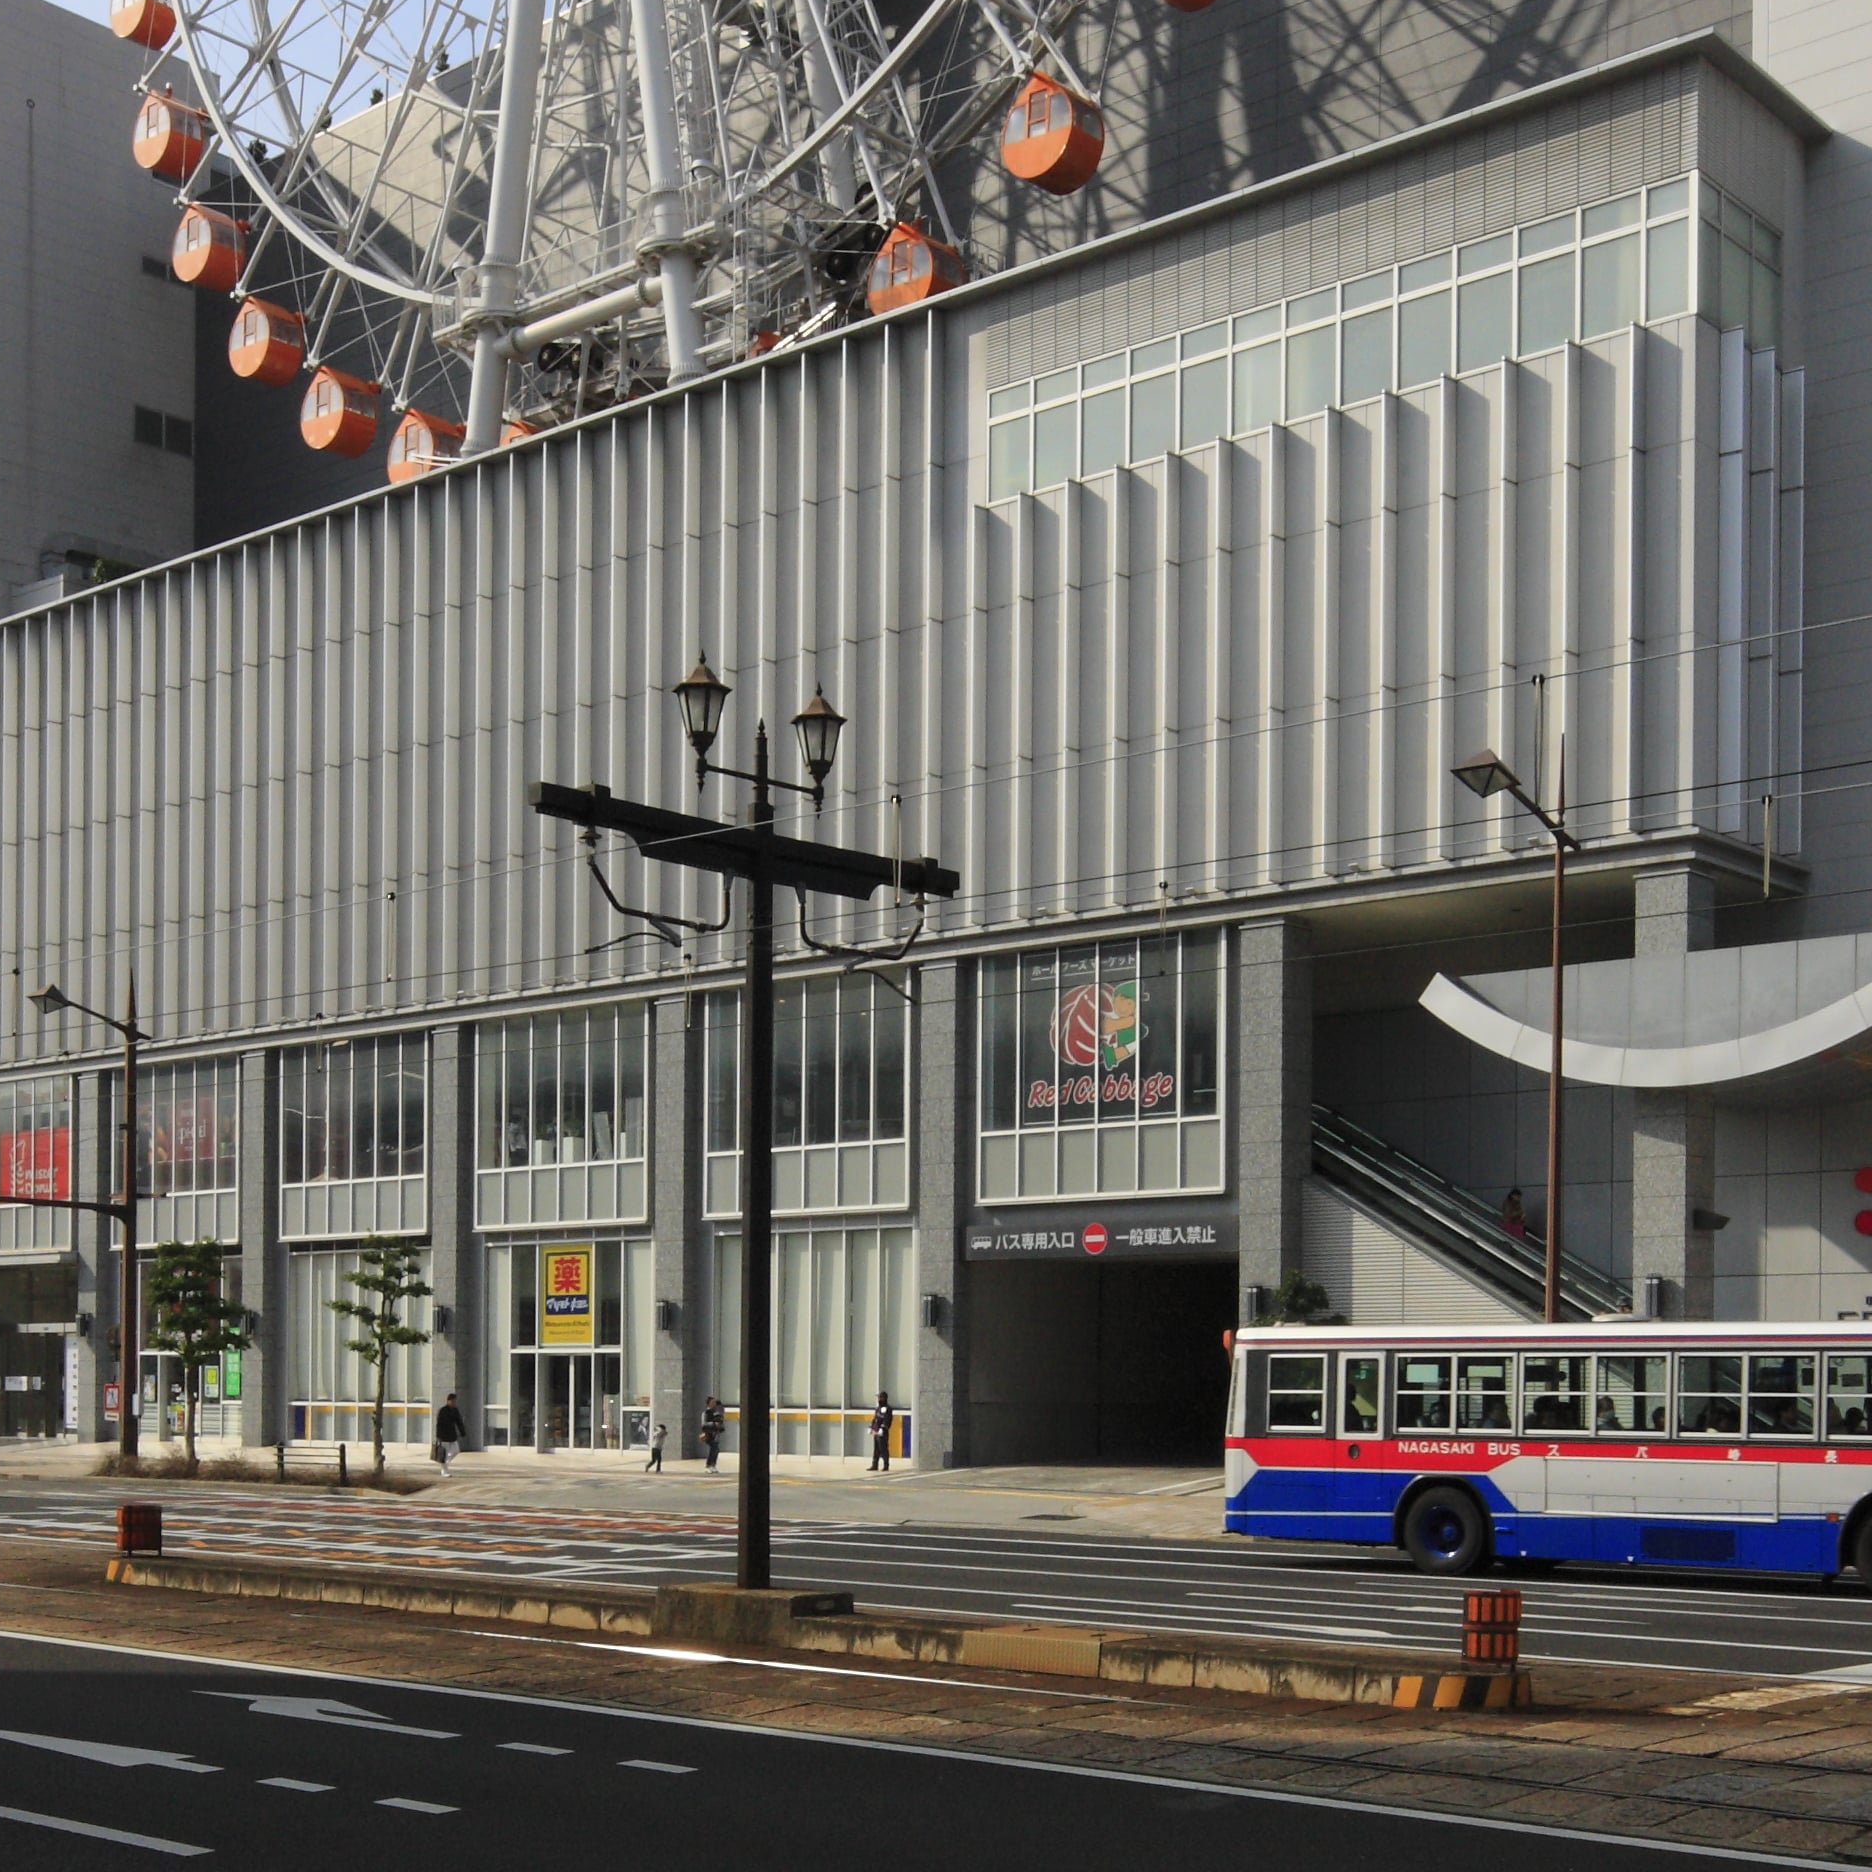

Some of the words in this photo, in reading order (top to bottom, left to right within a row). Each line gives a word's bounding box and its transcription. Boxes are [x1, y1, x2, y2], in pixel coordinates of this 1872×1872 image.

[1028, 1079, 1074, 1107] Red
[1073, 1072, 1174, 1107] Cabbage
[995, 1231, 1075, 1251] バス専用入口
[1115, 1225, 1217, 1246] 一般車進入禁止
[554, 1257, 581, 1293] 薬
[1397, 1441, 1475, 1456] NAGASAKI
[1487, 1443, 1521, 1457] BUS
